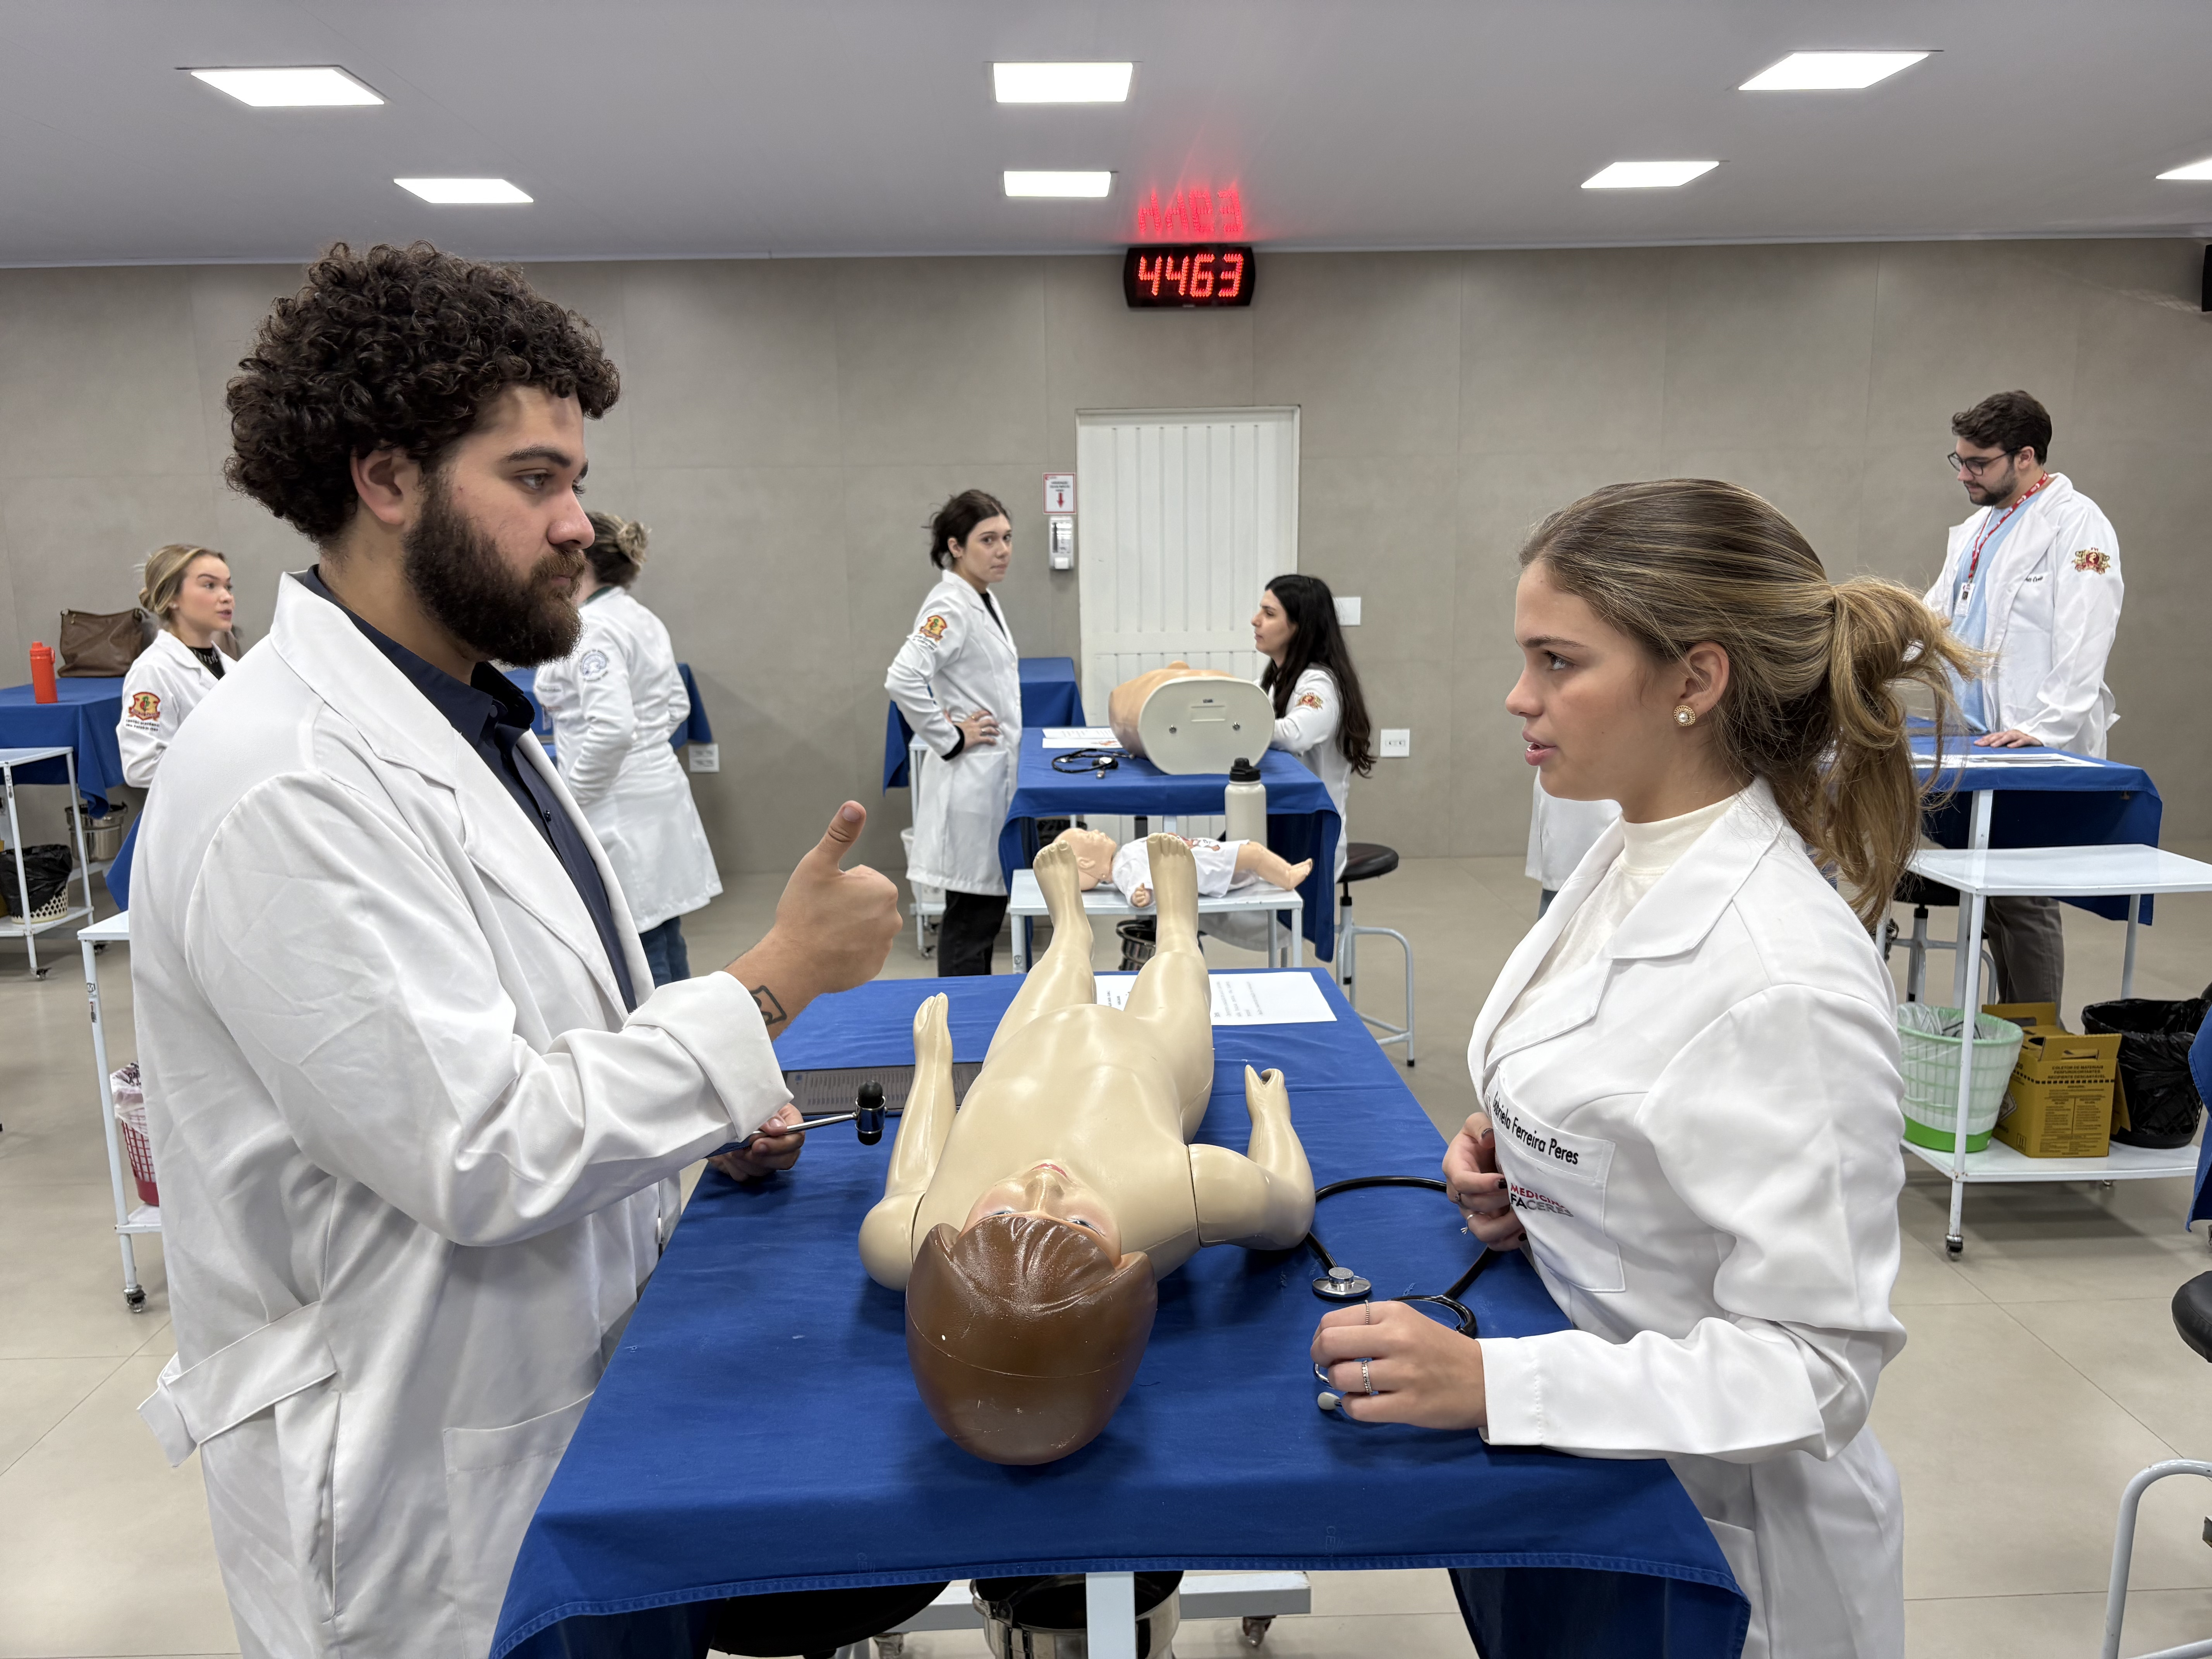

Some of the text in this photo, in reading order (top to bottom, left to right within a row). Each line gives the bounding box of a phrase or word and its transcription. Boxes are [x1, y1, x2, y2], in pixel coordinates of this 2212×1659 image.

[1138, 253, 1244, 297] 4463
[1512, 1117, 1546, 1152] Ferreira
[1549, 1138, 1579, 1165] Peres
